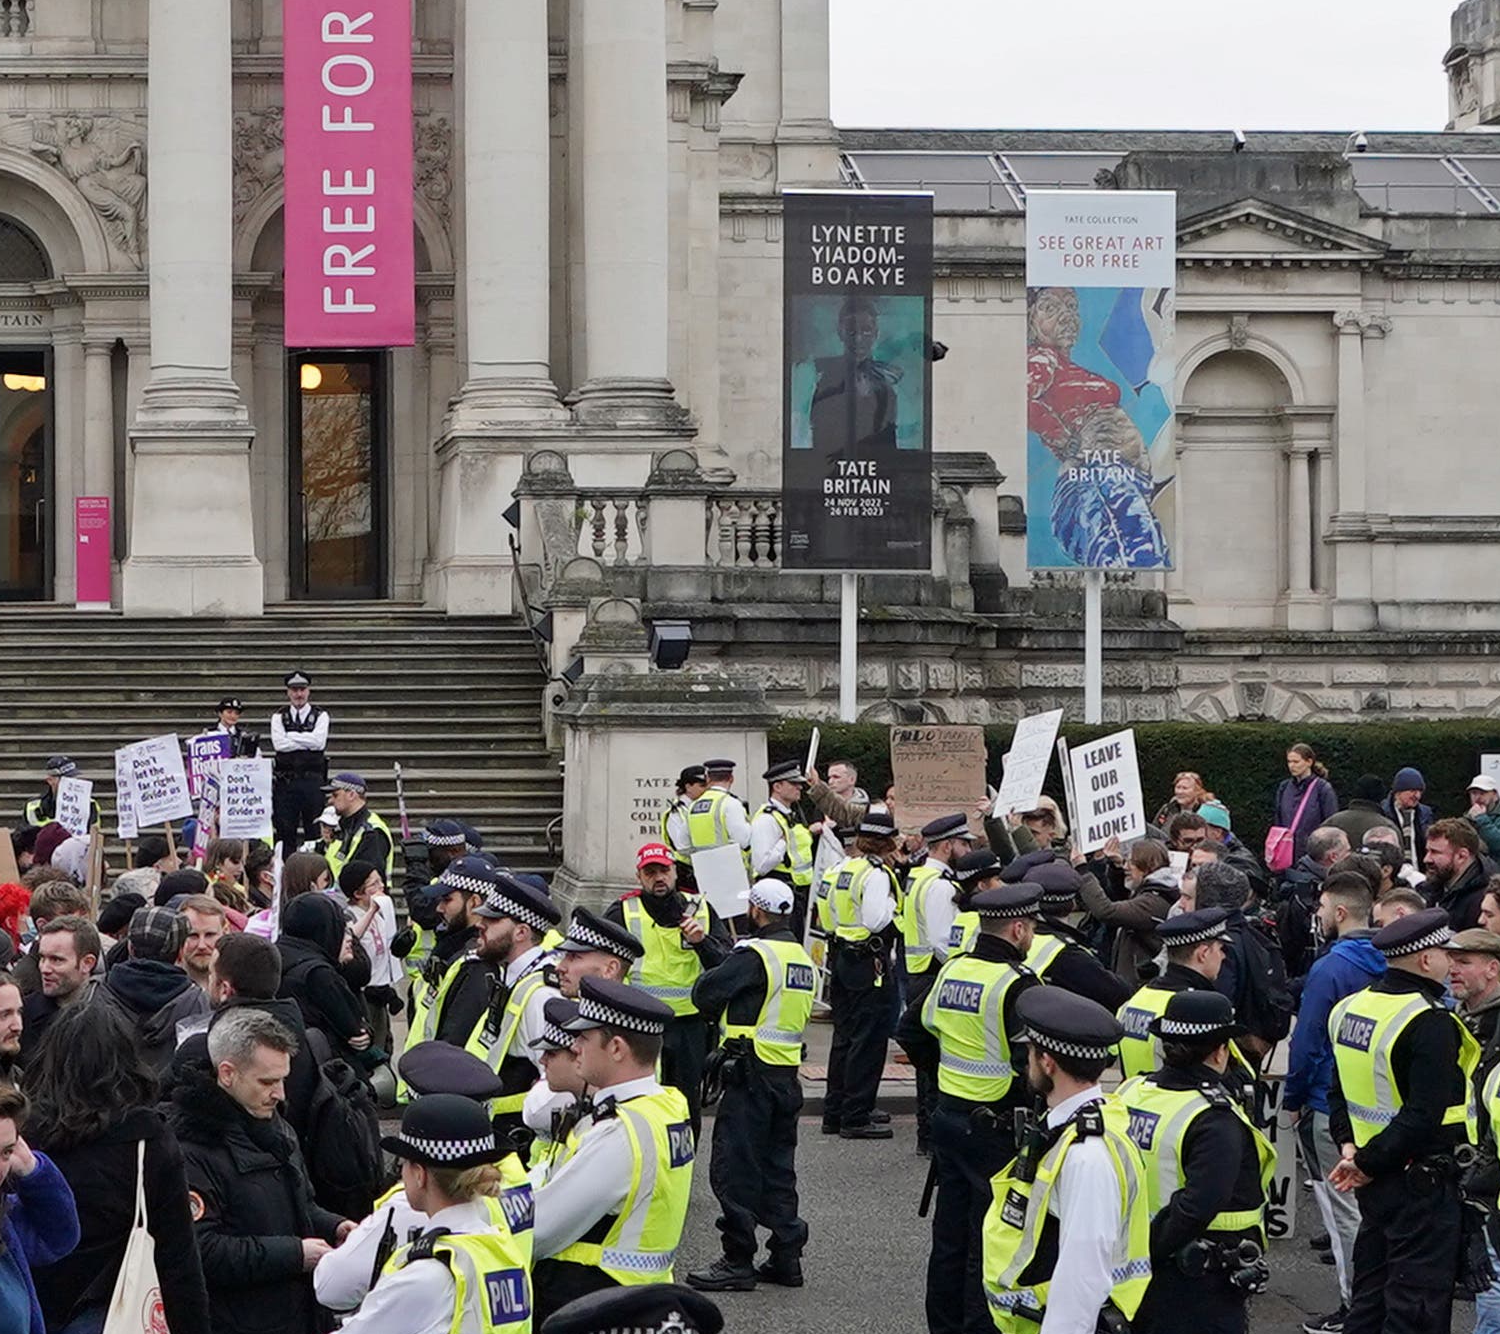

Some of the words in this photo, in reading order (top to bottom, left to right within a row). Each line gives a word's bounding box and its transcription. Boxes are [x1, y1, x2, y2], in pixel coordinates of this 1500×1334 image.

[322, 10, 376, 132] FOR
[1065, 216, 1084, 224] TATE
[1086, 215, 1139, 224] COLLECTION
[321, 166, 377, 314] FREE
[811, 225, 906, 244] LYNETTE
[1038, 235, 1068, 251] SEE
[1072, 235, 1129, 251] GREAT
[1132, 235, 1165, 250] ART
[811, 246, 905, 265] YIADOM-
[1063, 254, 1097, 268] FOR
[1102, 253, 1140, 268] FREE
[811, 267, 905, 285] BOAKYE
[1083, 450, 1122, 465] TATE
[837, 461, 877, 477] TATE
[1068, 467, 1136, 483] BRITAIN
[823, 479, 892, 495] BRITAIN
[824, 498, 835, 507] 24
[837, 498, 857, 507] NOV
[859, 498, 882, 507] 2022
[830, 507, 841, 516] 26
[843, 507, 859, 516] FEB
[860, 507, 884, 516] 2023
[190, 740, 222, 757] Trans
[1083, 741, 1123, 769] LEAVE
[132, 756, 157, 769] Don't
[134, 770, 148, 780] let
[149, 767, 165, 776] the
[226, 774, 251, 784] Don't
[1091, 769, 1119, 792] OUR
[137, 782, 150, 791] far
[153, 775, 176, 788] right
[226, 786, 240, 794] let
[240, 785, 255, 794] the
[635, 778, 671, 788] TATE
[141, 789, 167, 802] divide
[169, 786, 181, 795] us
[227, 797, 240, 805] far
[242, 796, 263, 806] right
[633, 798, 661, 808] THE
[1092, 791, 1126, 815] KIDS
[227, 807, 254, 816] divide
[1087, 818, 1129, 844] ALONE
[939, 983, 981, 1008] POLICE
